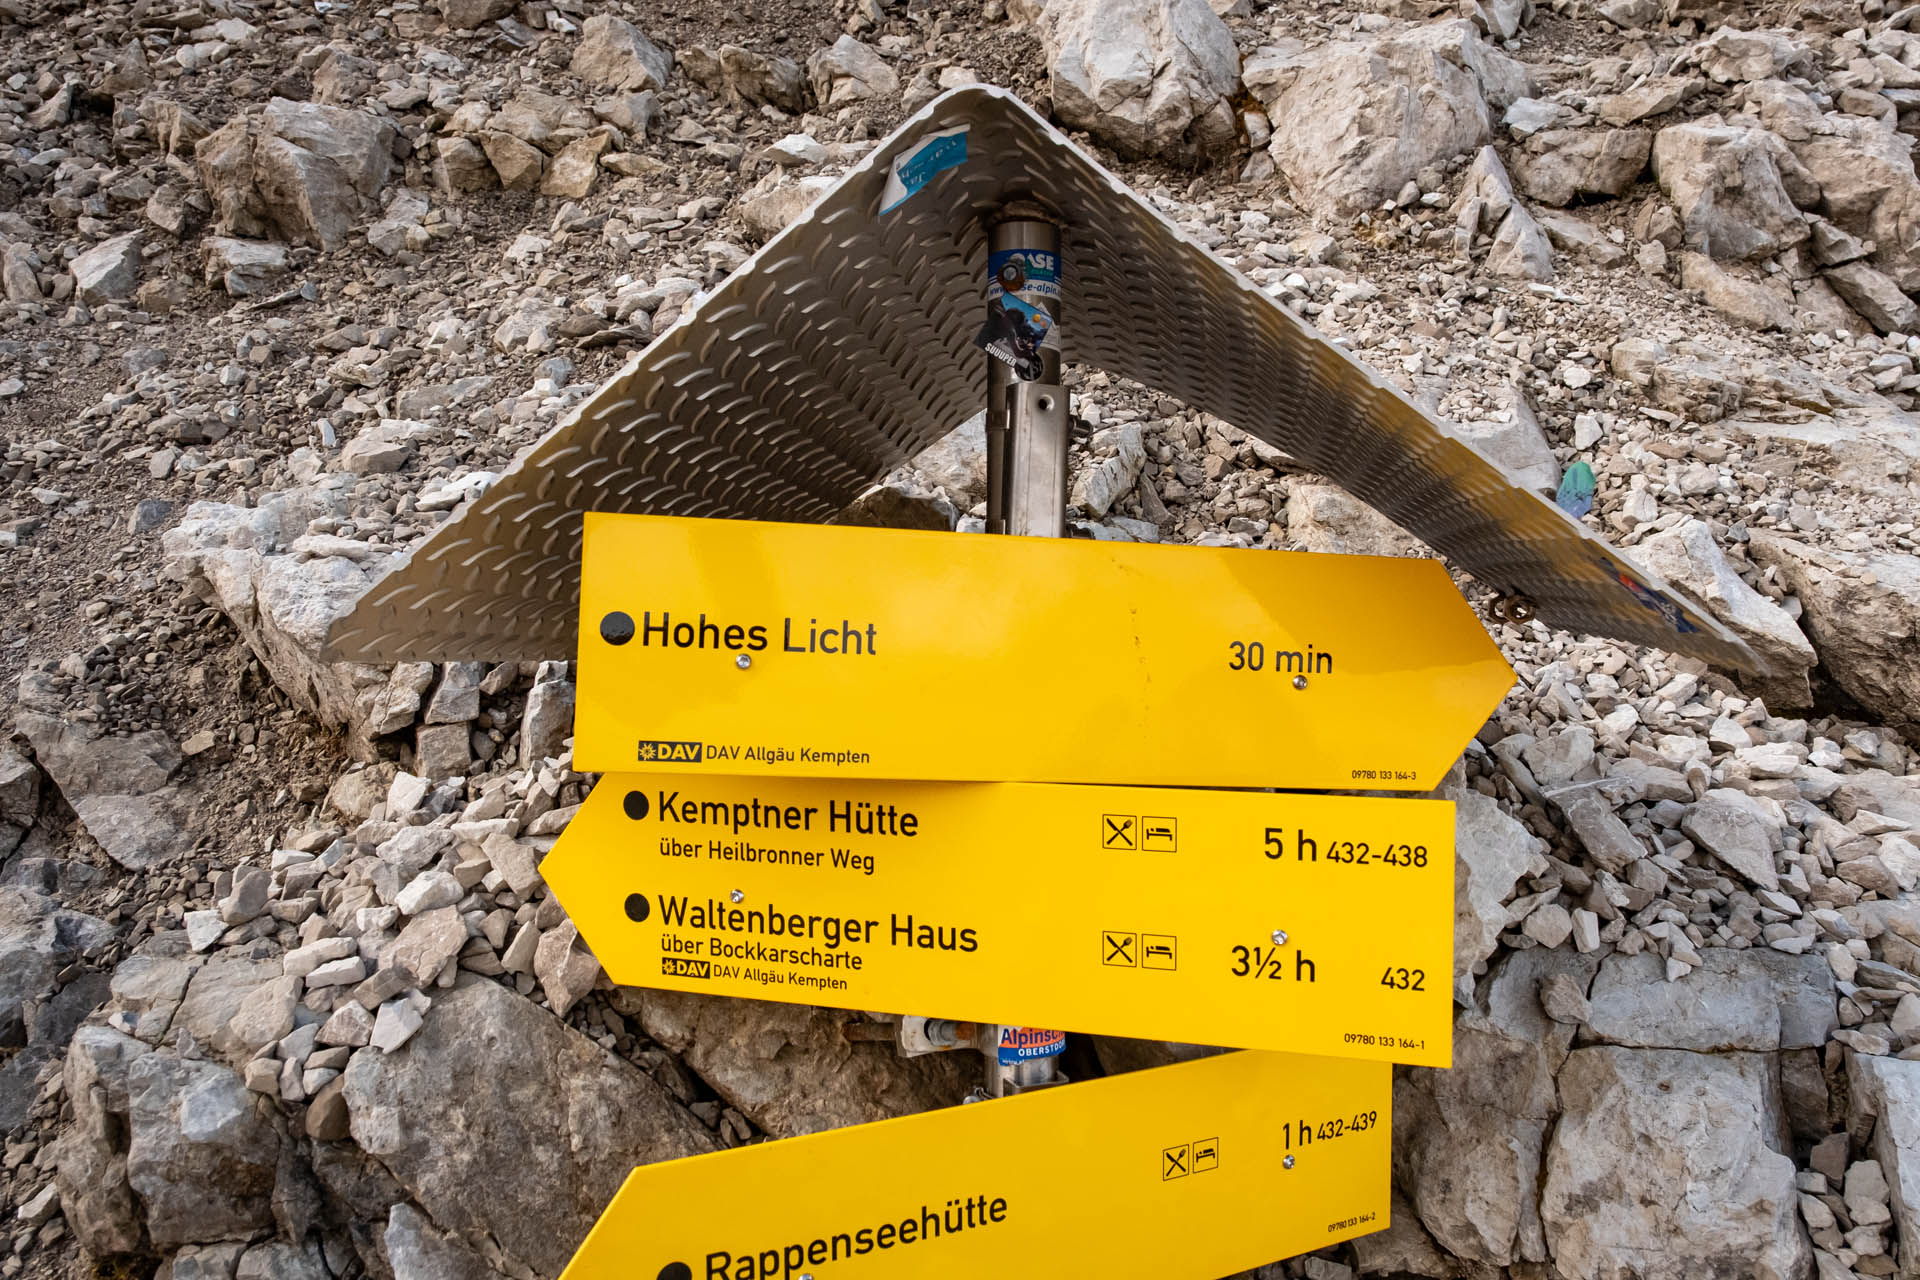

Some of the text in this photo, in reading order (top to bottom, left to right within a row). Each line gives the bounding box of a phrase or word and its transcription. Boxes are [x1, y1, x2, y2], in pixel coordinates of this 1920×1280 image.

[985, 342, 1017, 367] SUUUPER
[642, 611, 877, 656] Hohes Licht
[1228, 640, 1333, 675] 30 min
[656, 743, 870, 767] DAV DAV Allgäu Kempten
[1351, 769, 1417, 781] 09780 133 164-3
[659, 790, 919, 838] Kemptner Hütte
[659, 837, 875, 876] über Heilbronner Weg
[1264, 827, 1428, 868] 5 h 432-438
[657, 894, 979, 953] Waltenberger Haus
[661, 933, 864, 971] über Bockkarscharte
[1295, 949, 1316, 983] h
[677, 961, 848, 991] DAV DAV Allgäu Kempten
[1380, 967, 1425, 992] 432
[1344, 1033, 1425, 1050] 09780 133 164-1
[1282, 1110, 1378, 1150] 1 h 432-439
[705, 1194, 1008, 1280] Rappenseehütte
[1327, 1211, 1376, 1233] 09780 133 164-2
